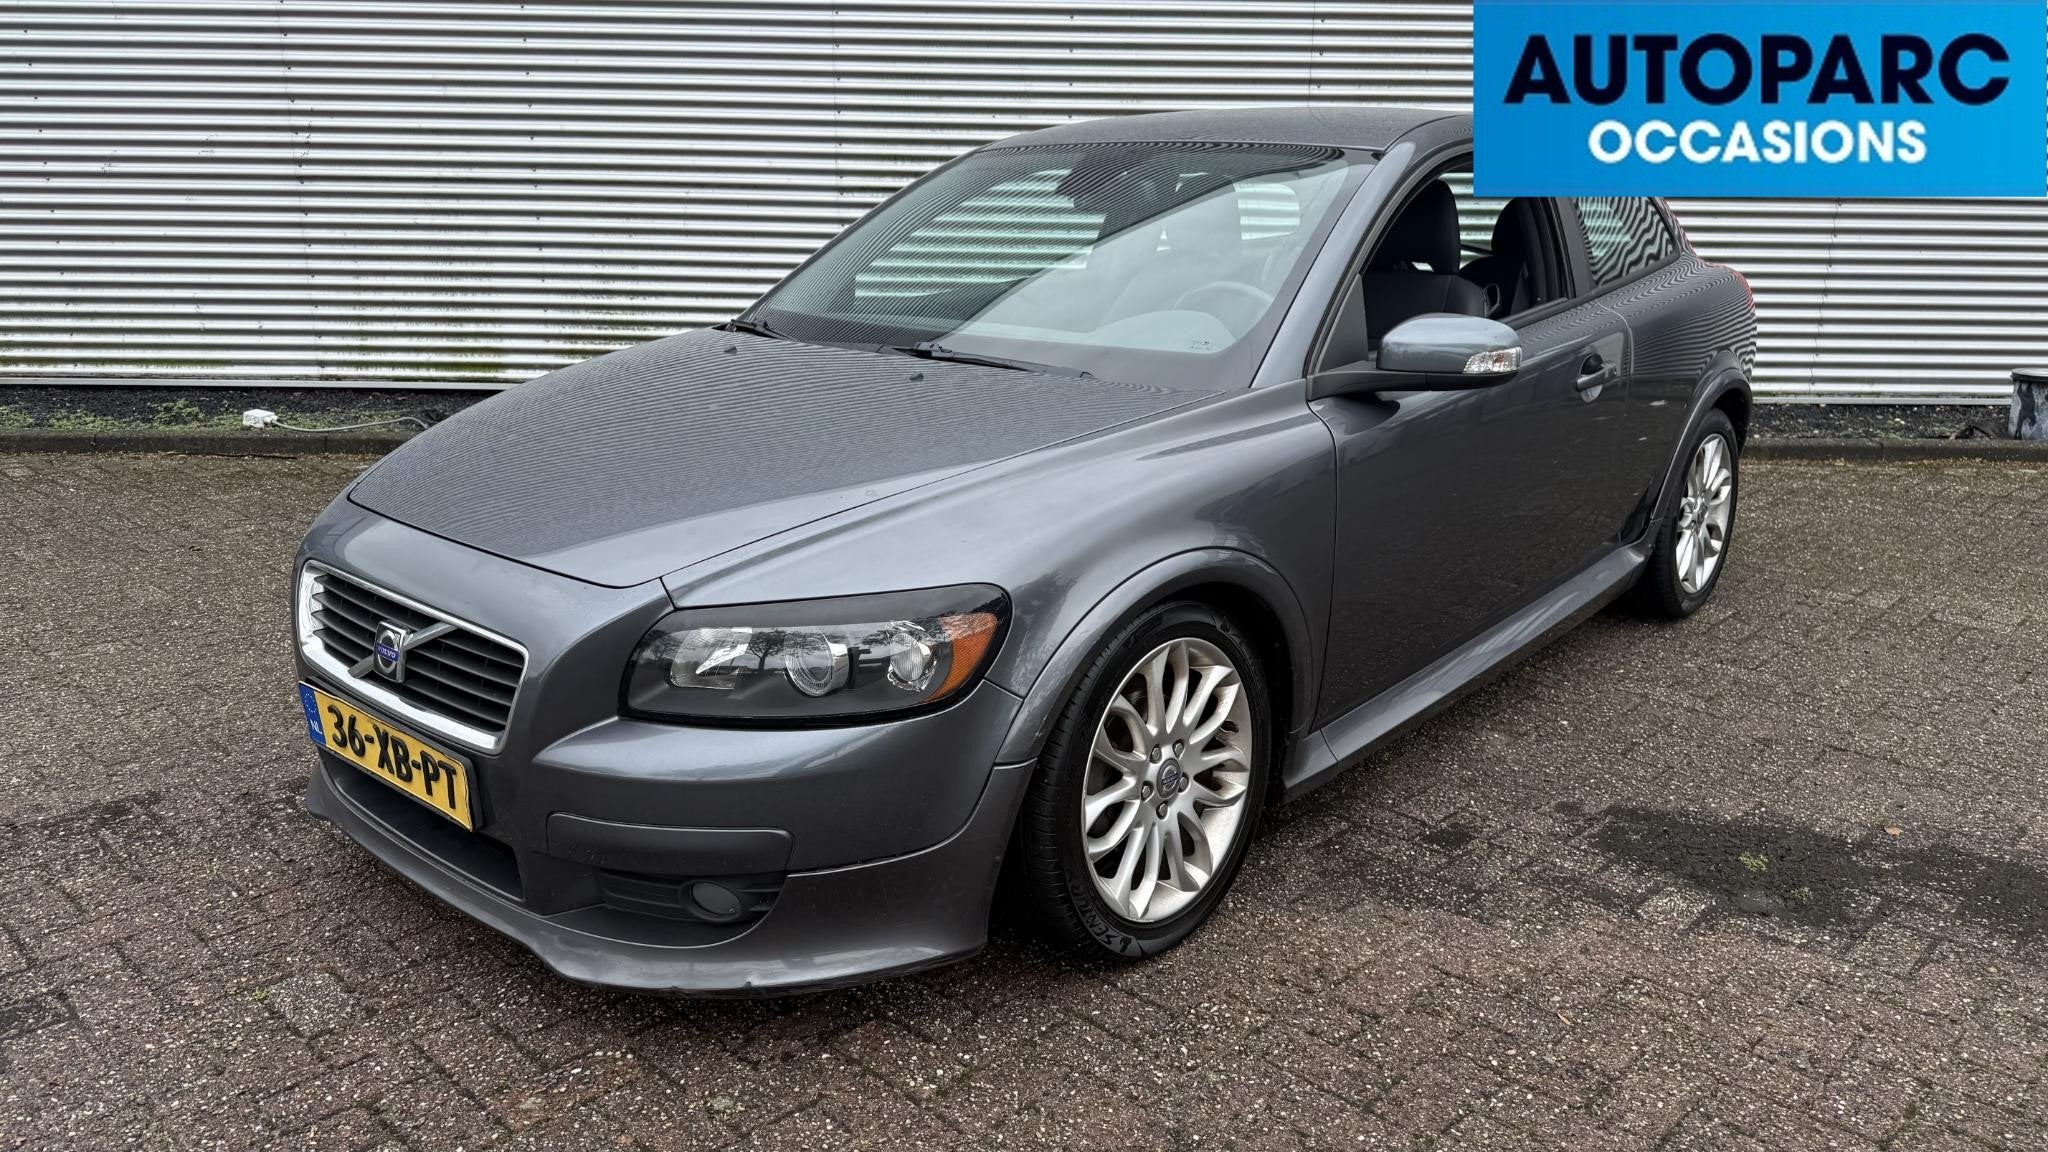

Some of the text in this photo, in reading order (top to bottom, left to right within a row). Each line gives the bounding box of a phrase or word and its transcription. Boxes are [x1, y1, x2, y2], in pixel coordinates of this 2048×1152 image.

[377, 645, 397, 659] VOLVO
[309, 719, 323, 735] NL
[326, 704, 457, 810] 36-XB-PT
